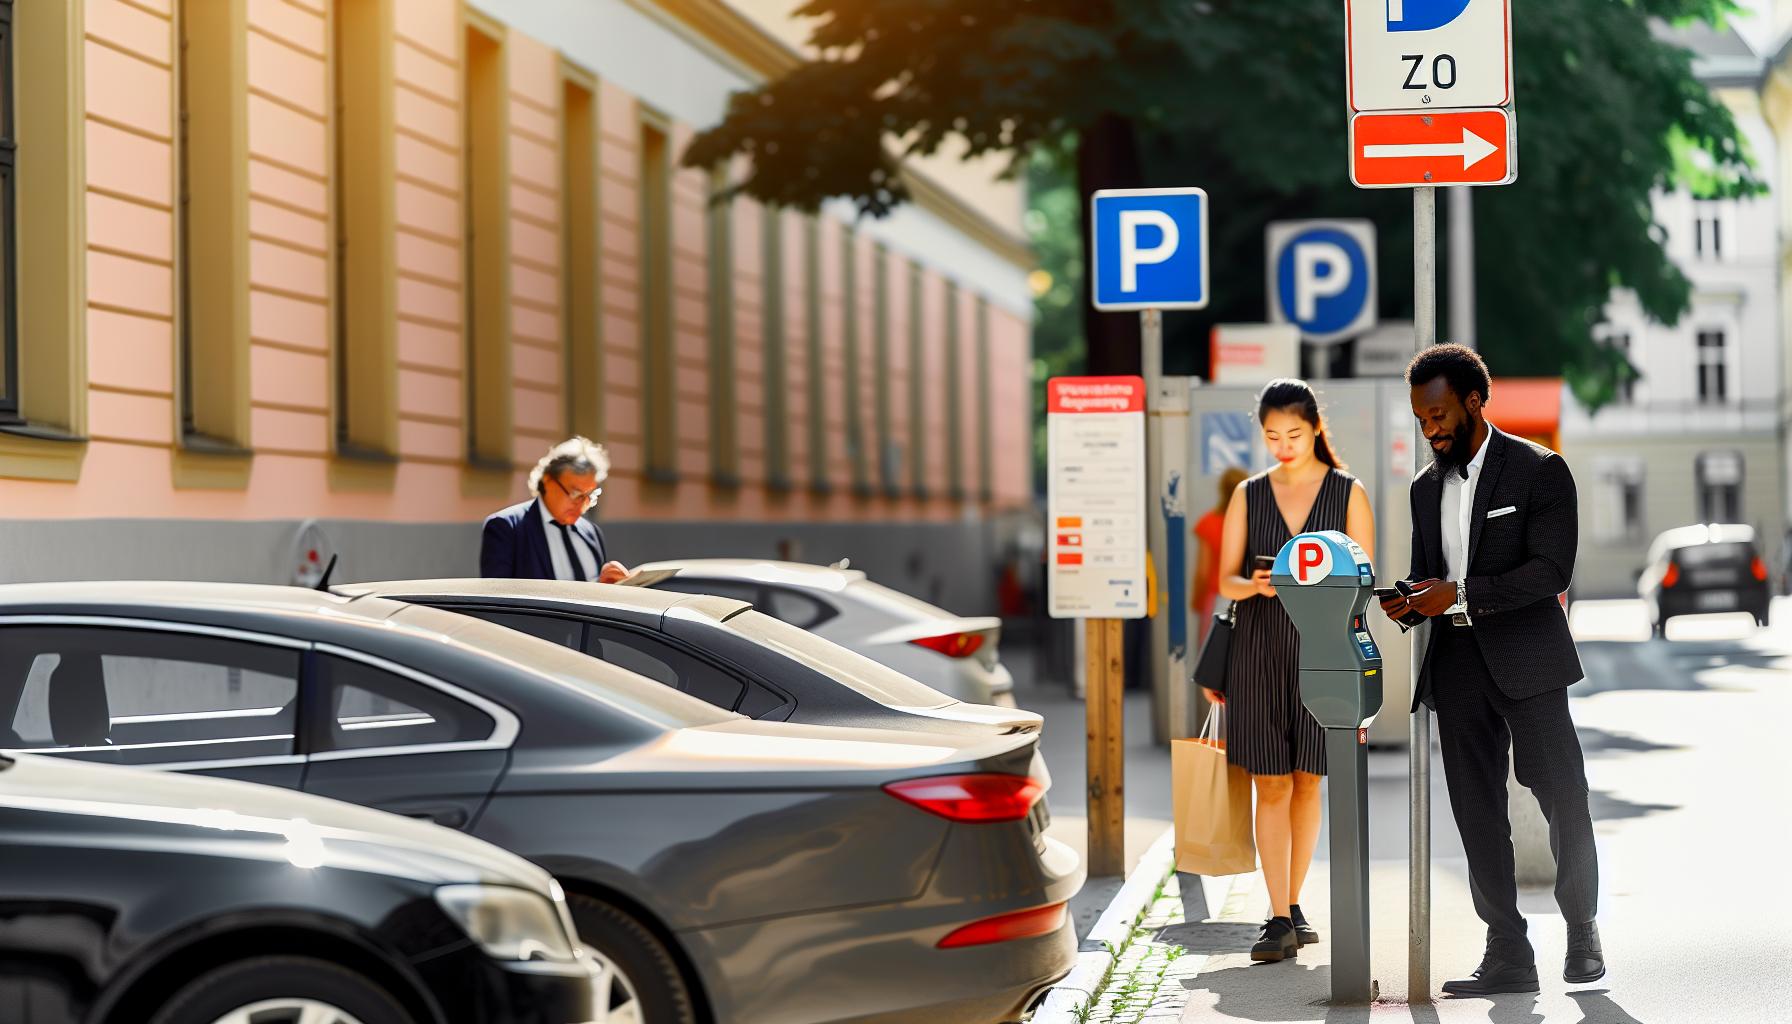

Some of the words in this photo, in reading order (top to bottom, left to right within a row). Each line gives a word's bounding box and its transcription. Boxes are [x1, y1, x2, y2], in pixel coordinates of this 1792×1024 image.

[1119, 210, 1179, 292] P
[1294, 242, 1352, 322] P
[1299, 543, 1324, 581] P
